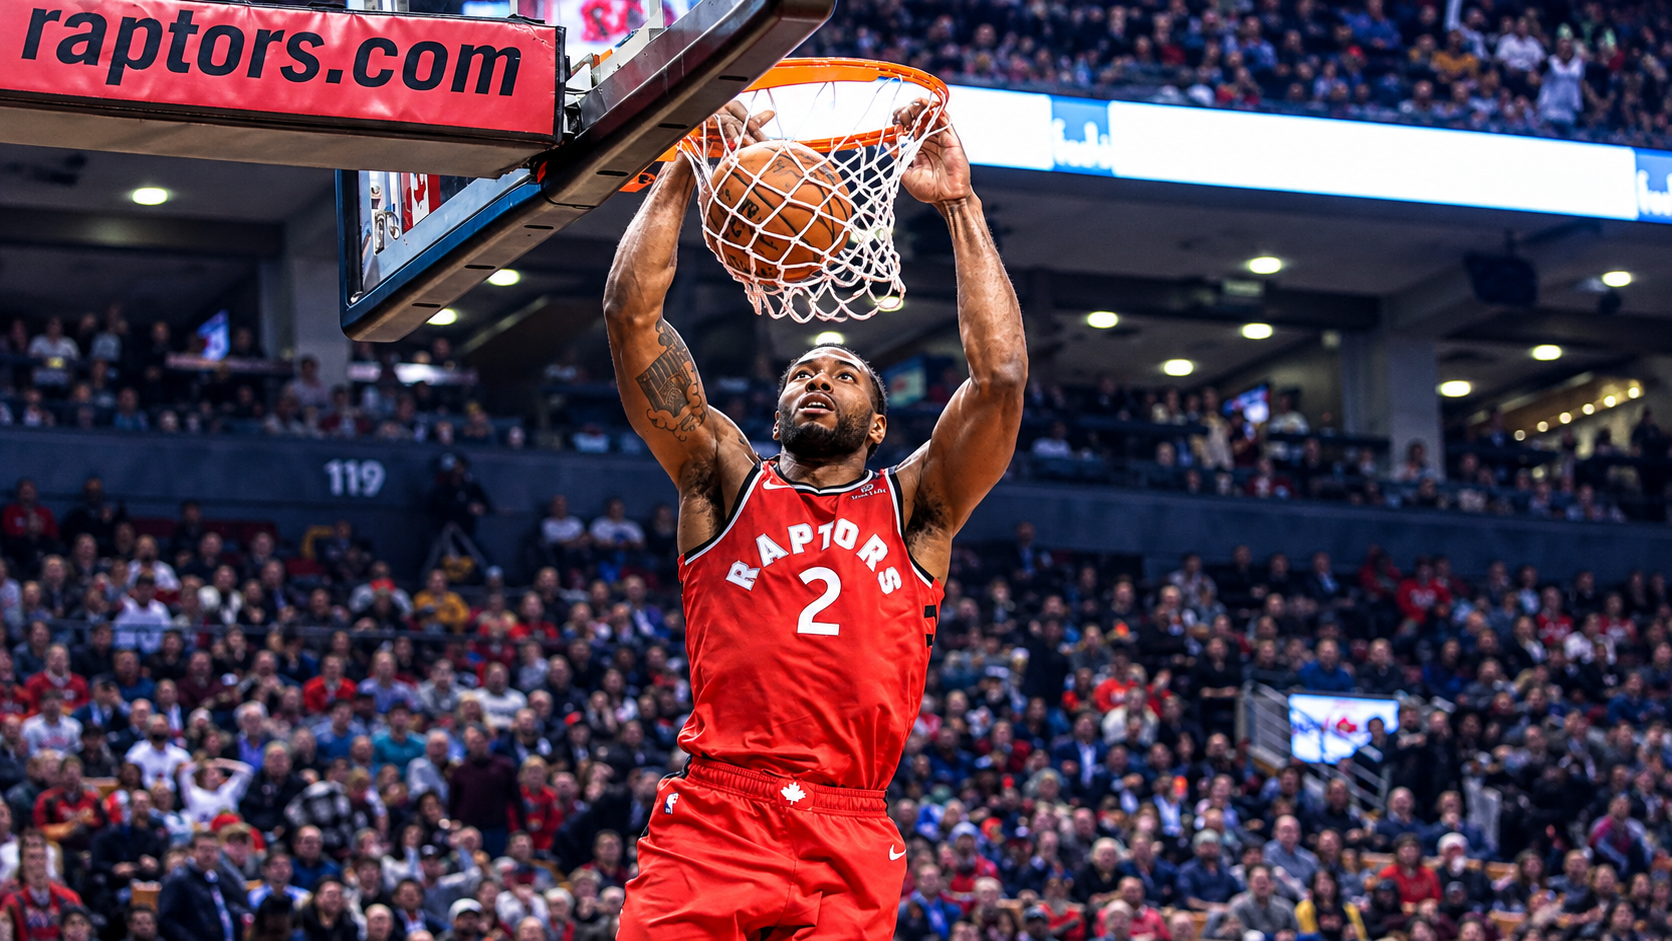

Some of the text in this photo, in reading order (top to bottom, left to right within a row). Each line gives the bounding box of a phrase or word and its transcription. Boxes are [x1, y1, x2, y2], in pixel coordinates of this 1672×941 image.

[21, 7, 522, 97] raptors.com
[323, 459, 386, 497] 119
[725, 518, 902, 595] RAPTORS
[797, 566, 842, 636] 2
